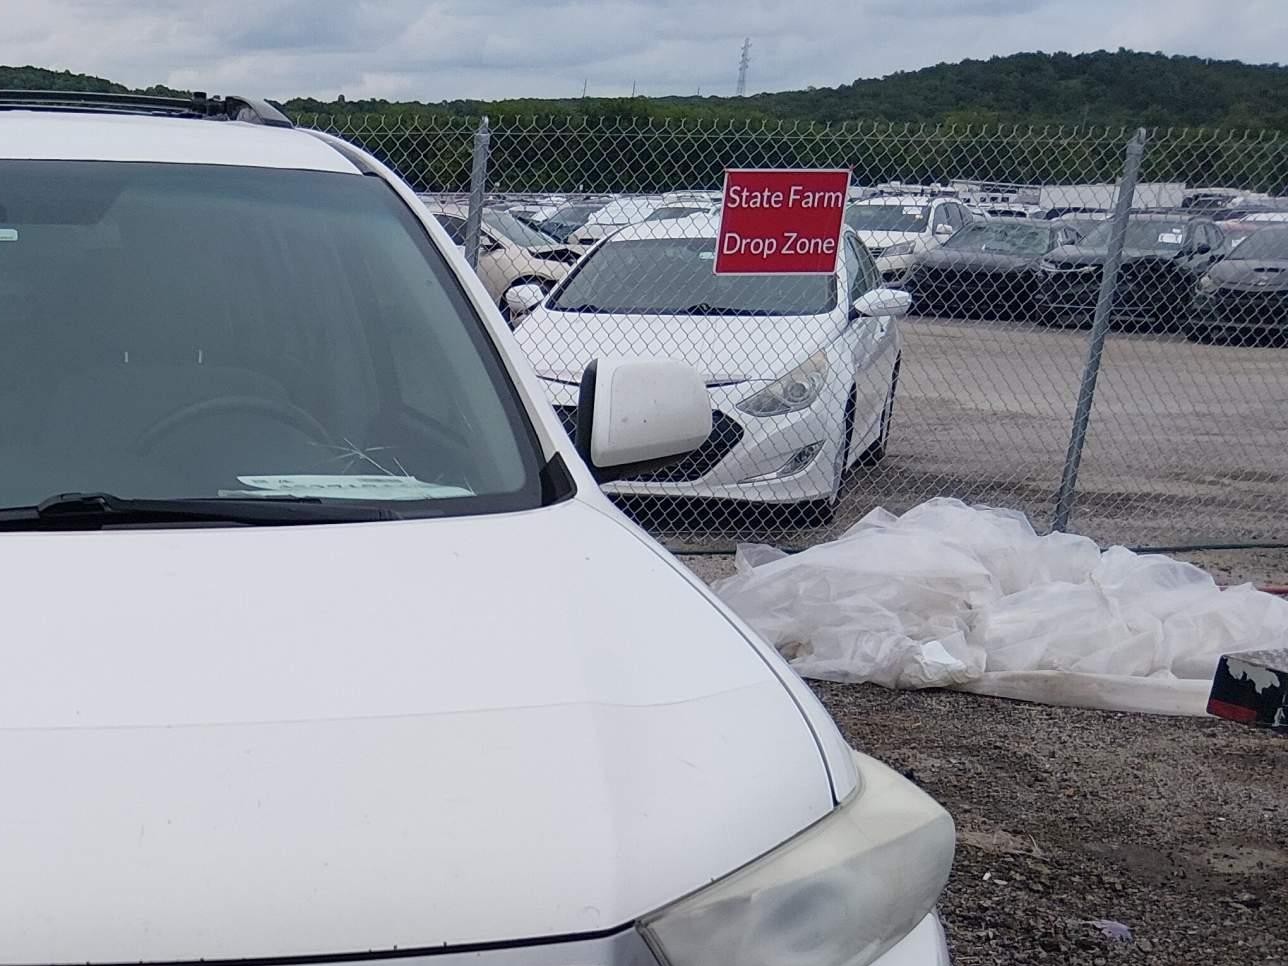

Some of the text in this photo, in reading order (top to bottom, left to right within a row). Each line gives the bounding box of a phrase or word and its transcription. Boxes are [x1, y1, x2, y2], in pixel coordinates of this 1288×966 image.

[727, 185, 843, 208] State Farm
[722, 232, 835, 259] Drop Zone
